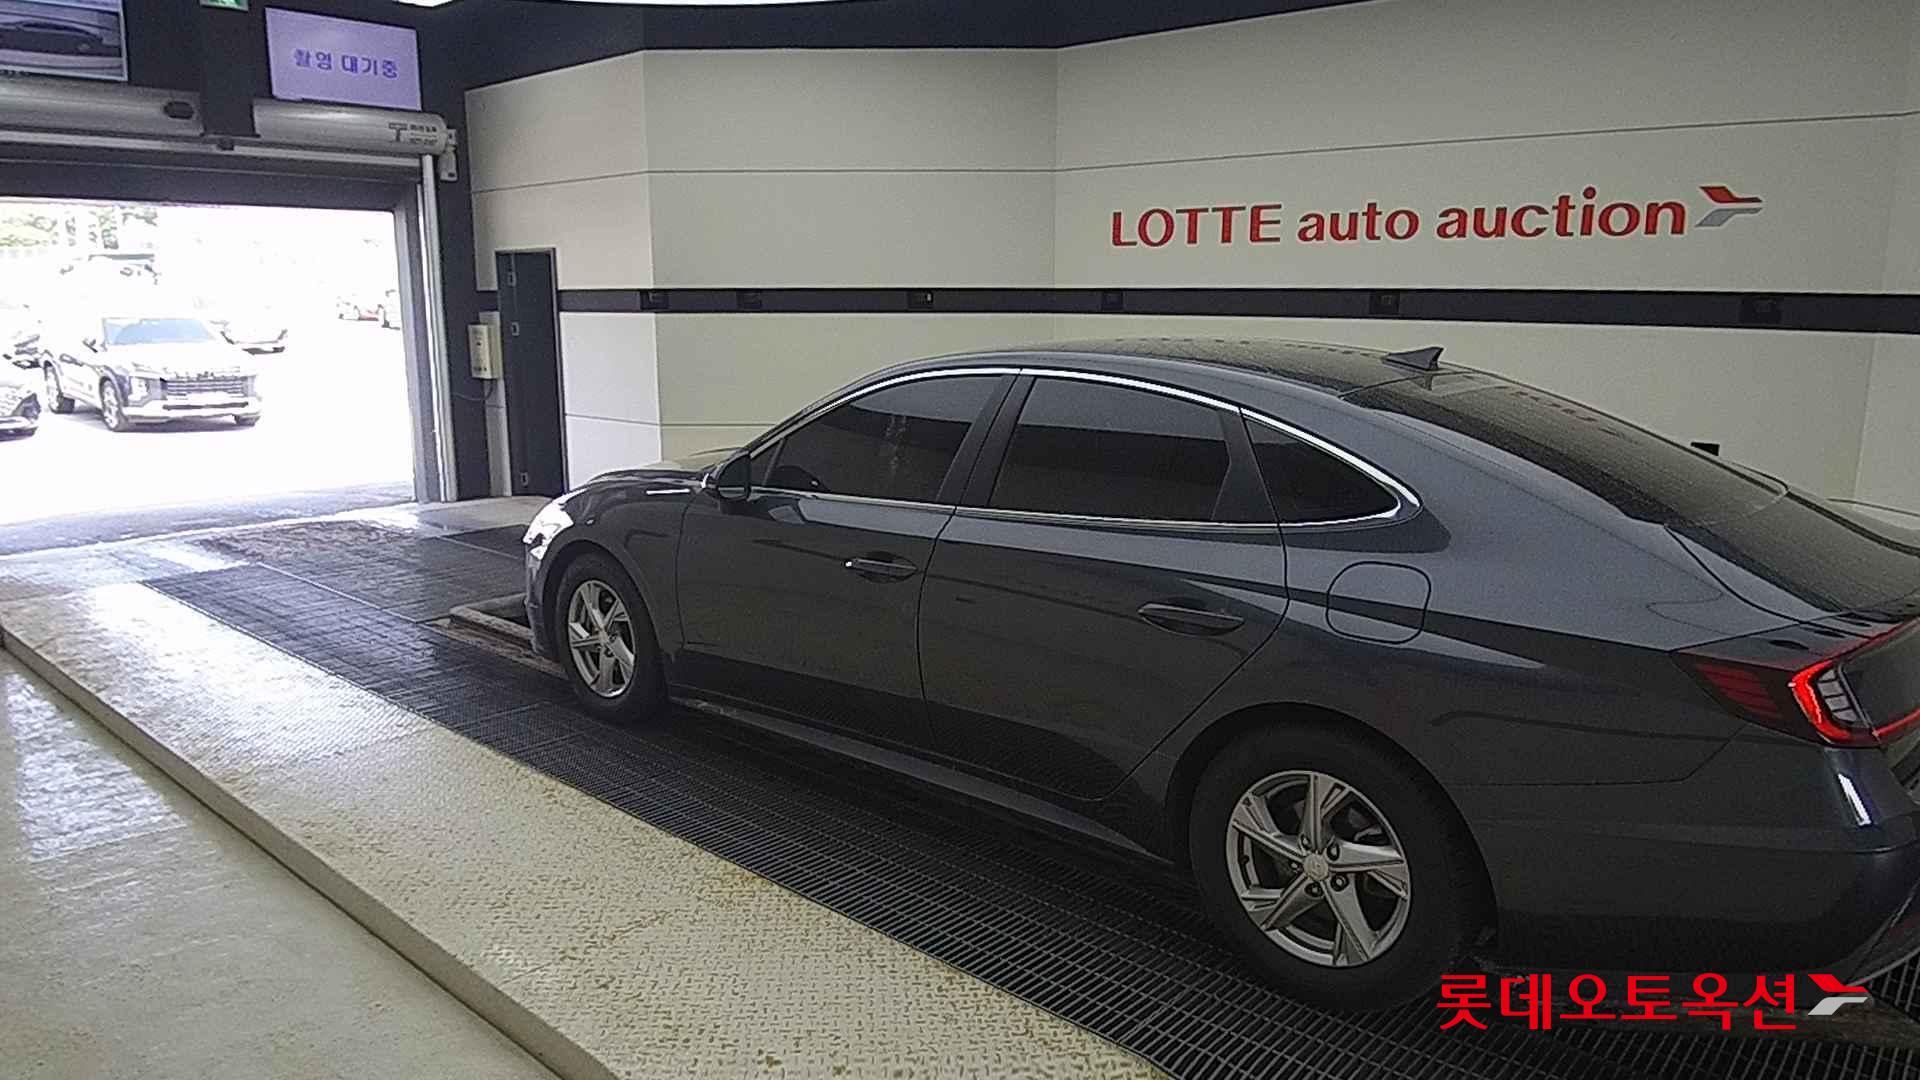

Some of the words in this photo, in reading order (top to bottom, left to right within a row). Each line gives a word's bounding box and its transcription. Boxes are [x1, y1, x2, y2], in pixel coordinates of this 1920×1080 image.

[341, 55, 397, 78] 대기중
[1112, 205, 1281, 247] LOTTE
[1297, 203, 1419, 243] auto
[1436, 187, 1686, 239] auction
